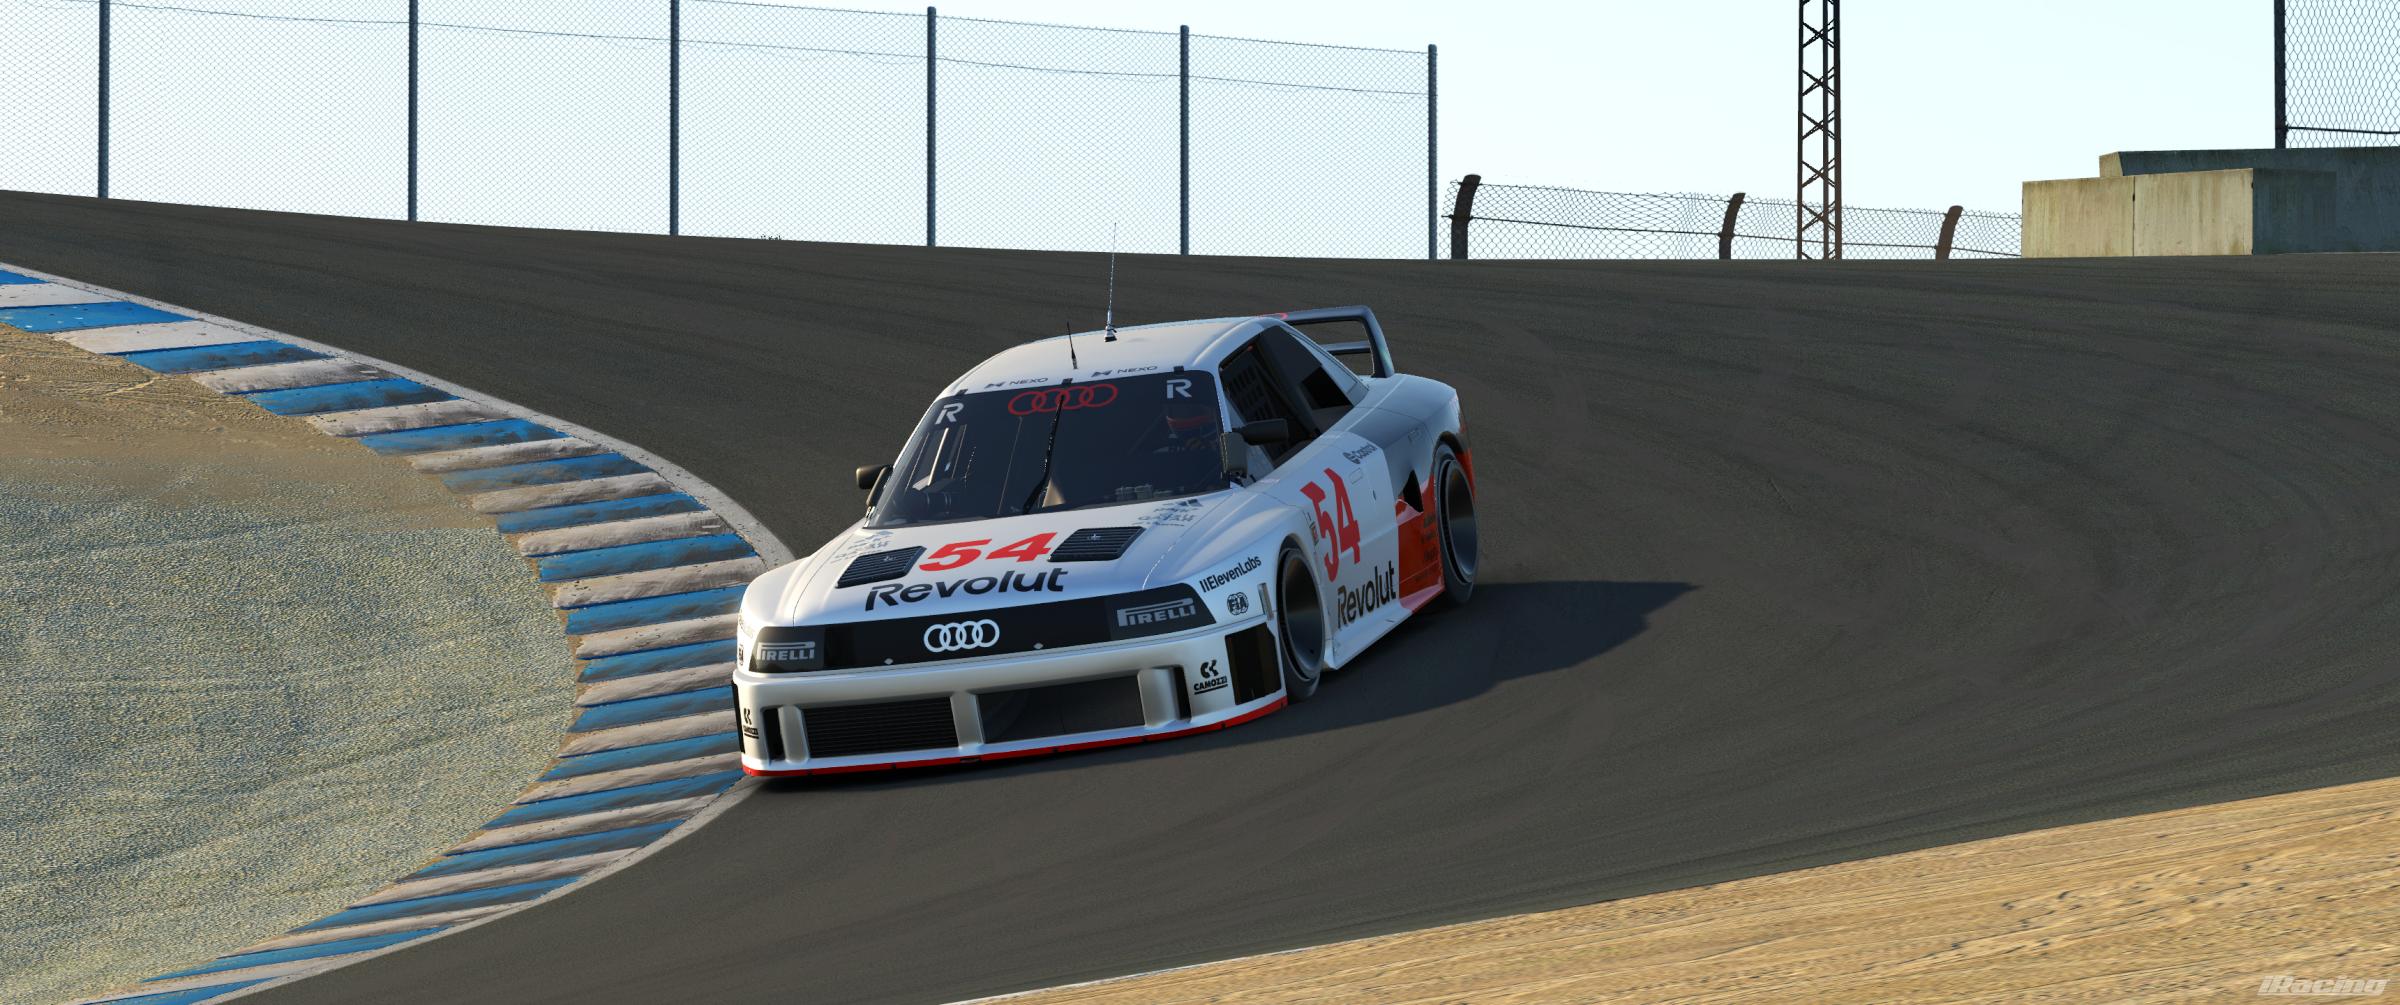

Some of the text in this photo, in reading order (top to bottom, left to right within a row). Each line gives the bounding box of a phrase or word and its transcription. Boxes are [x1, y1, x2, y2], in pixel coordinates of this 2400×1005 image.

[1009, 377, 1049, 386] NEXO
[1117, 365, 1158, 374] NEXO
[1300, 467, 1361, 583] 54
[919, 532, 1057, 572] 54
[865, 567, 1069, 612] Revolut
[1337, 560, 1397, 629] Revolut
[1116, 597, 1196, 627] PIRELLI
[757, 641, 816, 661] PIRELLI
[1193, 675, 1228, 691] CAMOZZI
